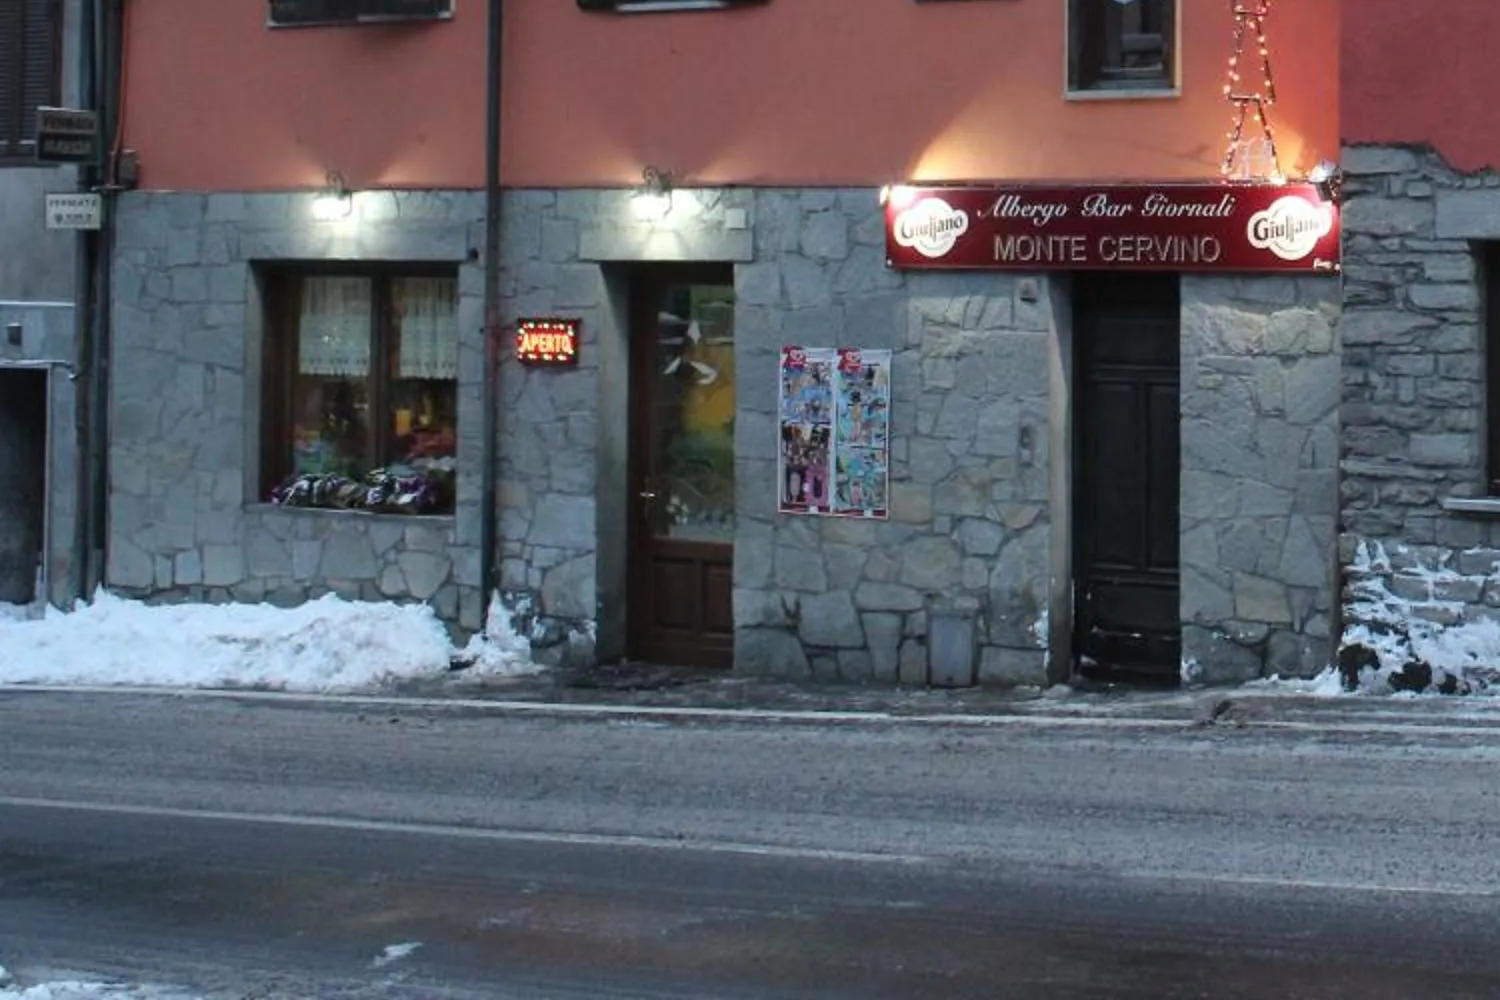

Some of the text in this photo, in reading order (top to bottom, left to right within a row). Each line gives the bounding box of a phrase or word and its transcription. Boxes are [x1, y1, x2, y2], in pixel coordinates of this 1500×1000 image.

[976, 193, 1235, 226] Albergo Bar Giornali
[994, 236, 1221, 262] MONTE CERVINO
[520, 333, 572, 353] APERTO
